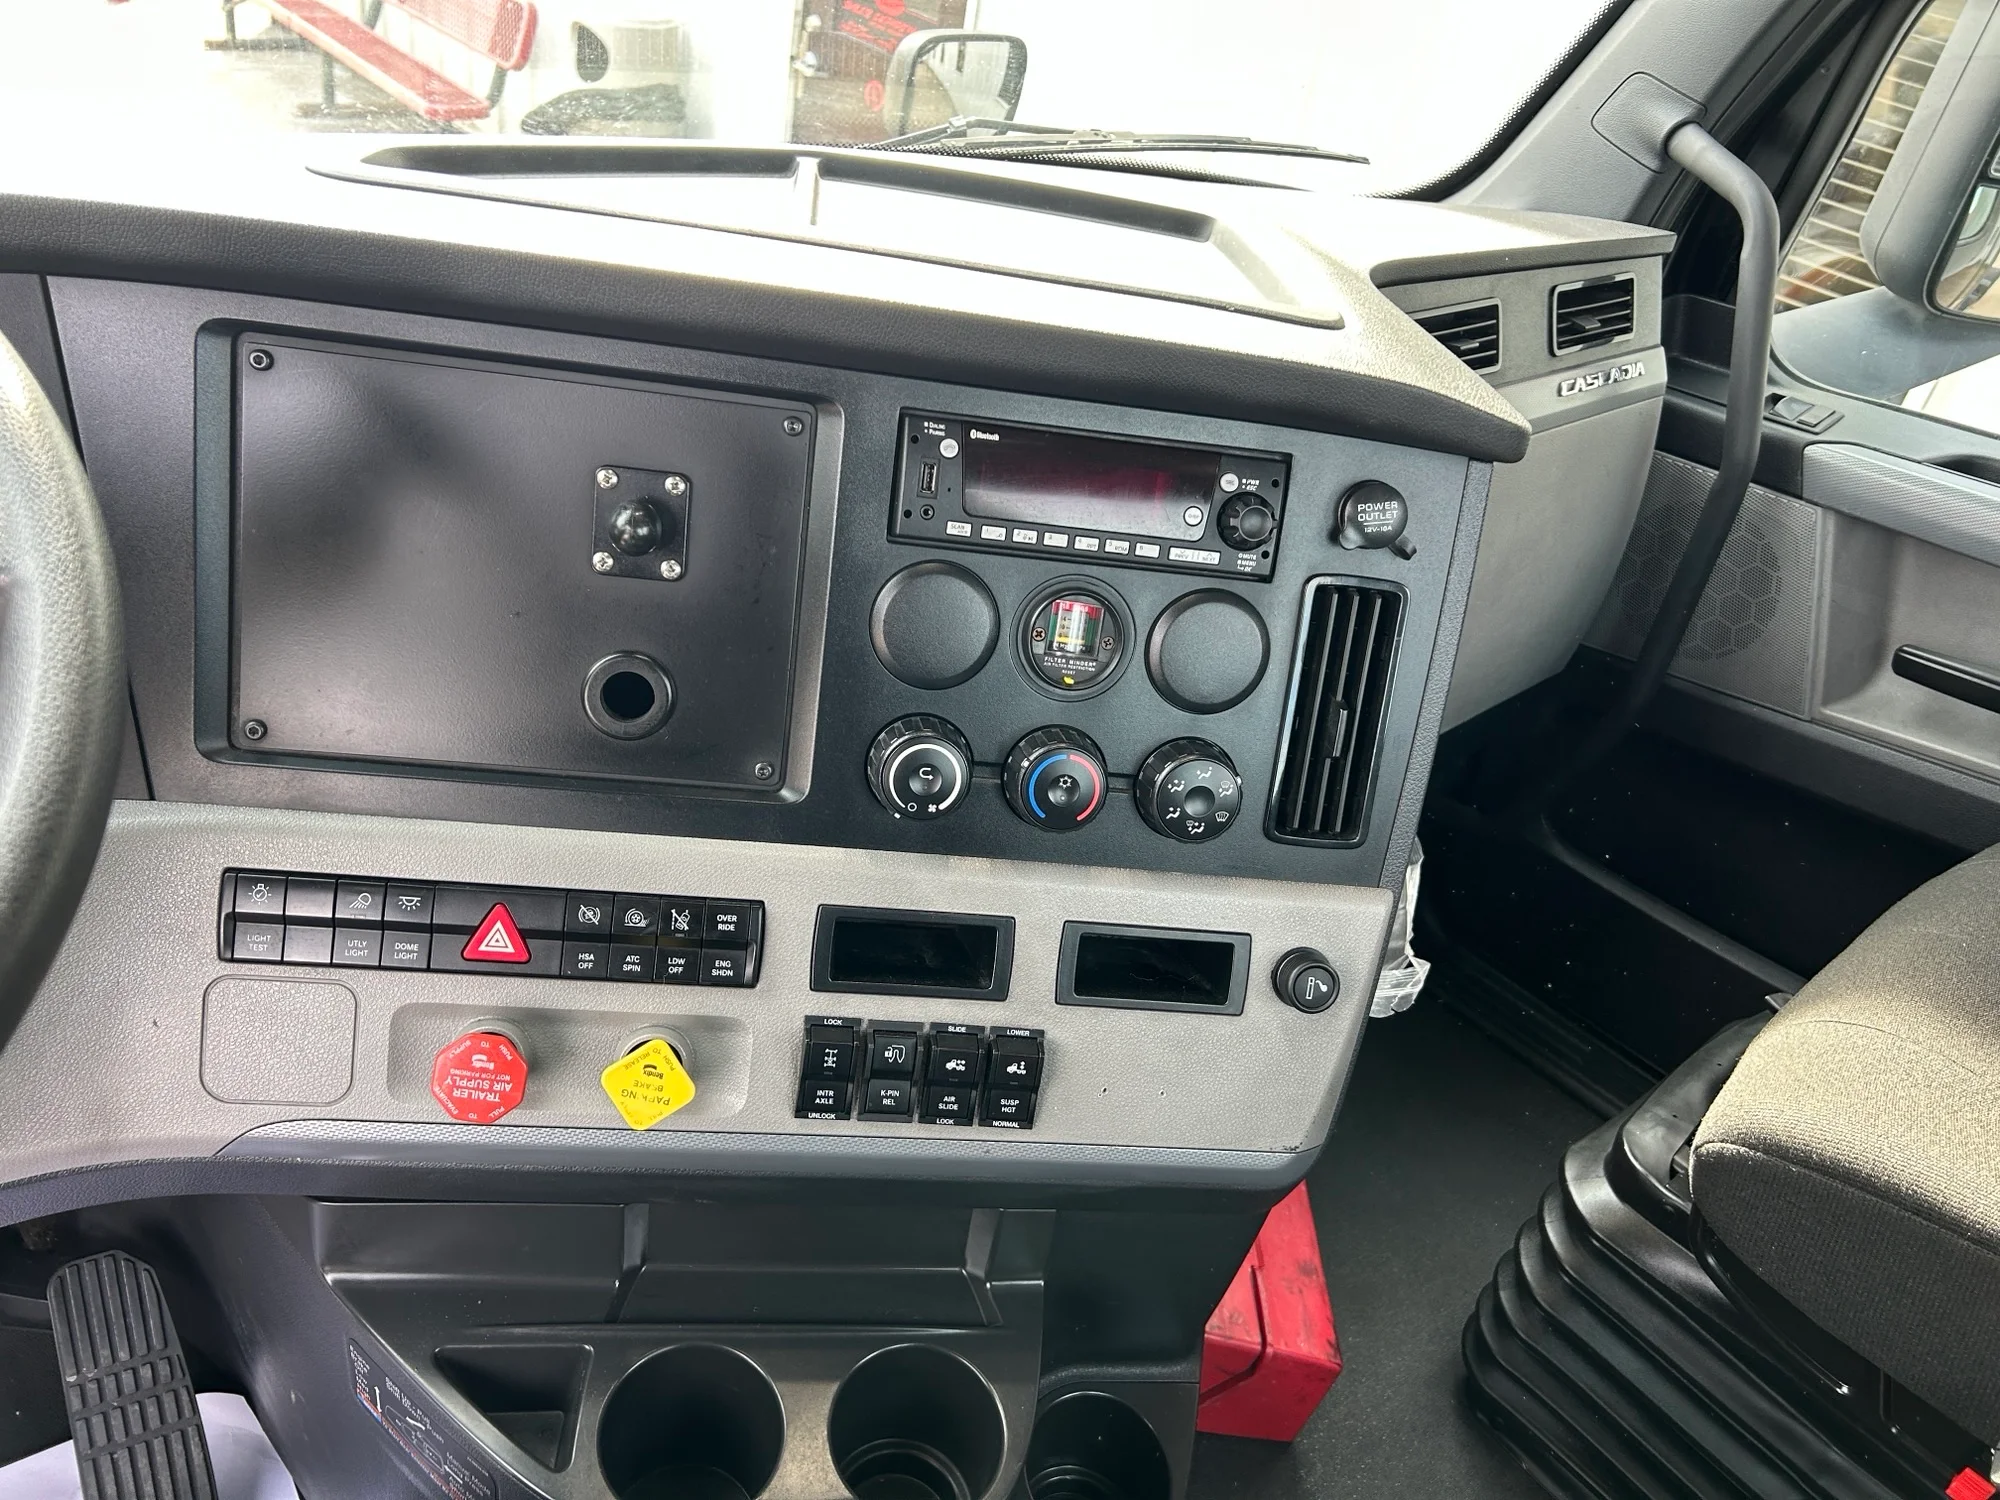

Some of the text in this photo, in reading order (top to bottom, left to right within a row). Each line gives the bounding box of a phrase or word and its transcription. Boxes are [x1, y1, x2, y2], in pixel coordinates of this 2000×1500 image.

[1358, 501, 1398, 512] POWER
[1358, 511, 1398, 522] OUTLET
[716, 914, 737, 922] OVER
[718, 923, 736, 931] RIDE
[348, 940, 367, 948] UTLY
[394, 942, 419, 951] DOME
[345, 949, 368, 957] LIGHT
[394, 952, 418, 960] LIGHT
[622, 964, 641, 972] SPIN
[715, 960, 731, 968] ENG
[668, 966, 684, 974] OFF
[712, 968, 733, 976] SHDN
[450, 1040, 472, 1059] SUPPLY
[498, 1044, 514, 1060] PUSH
[624, 1051, 650, 1070] RELEASE
[450, 1068, 480, 1078] PARKING
[642, 1070, 664, 1080] Bendix
[444, 1076, 513, 1092] AIR SUPPLY
[432, 1085, 459, 1114] EVACUATE
[452, 1088, 500, 1102] TRAILER
[488, 1106, 506, 1118] PULL
